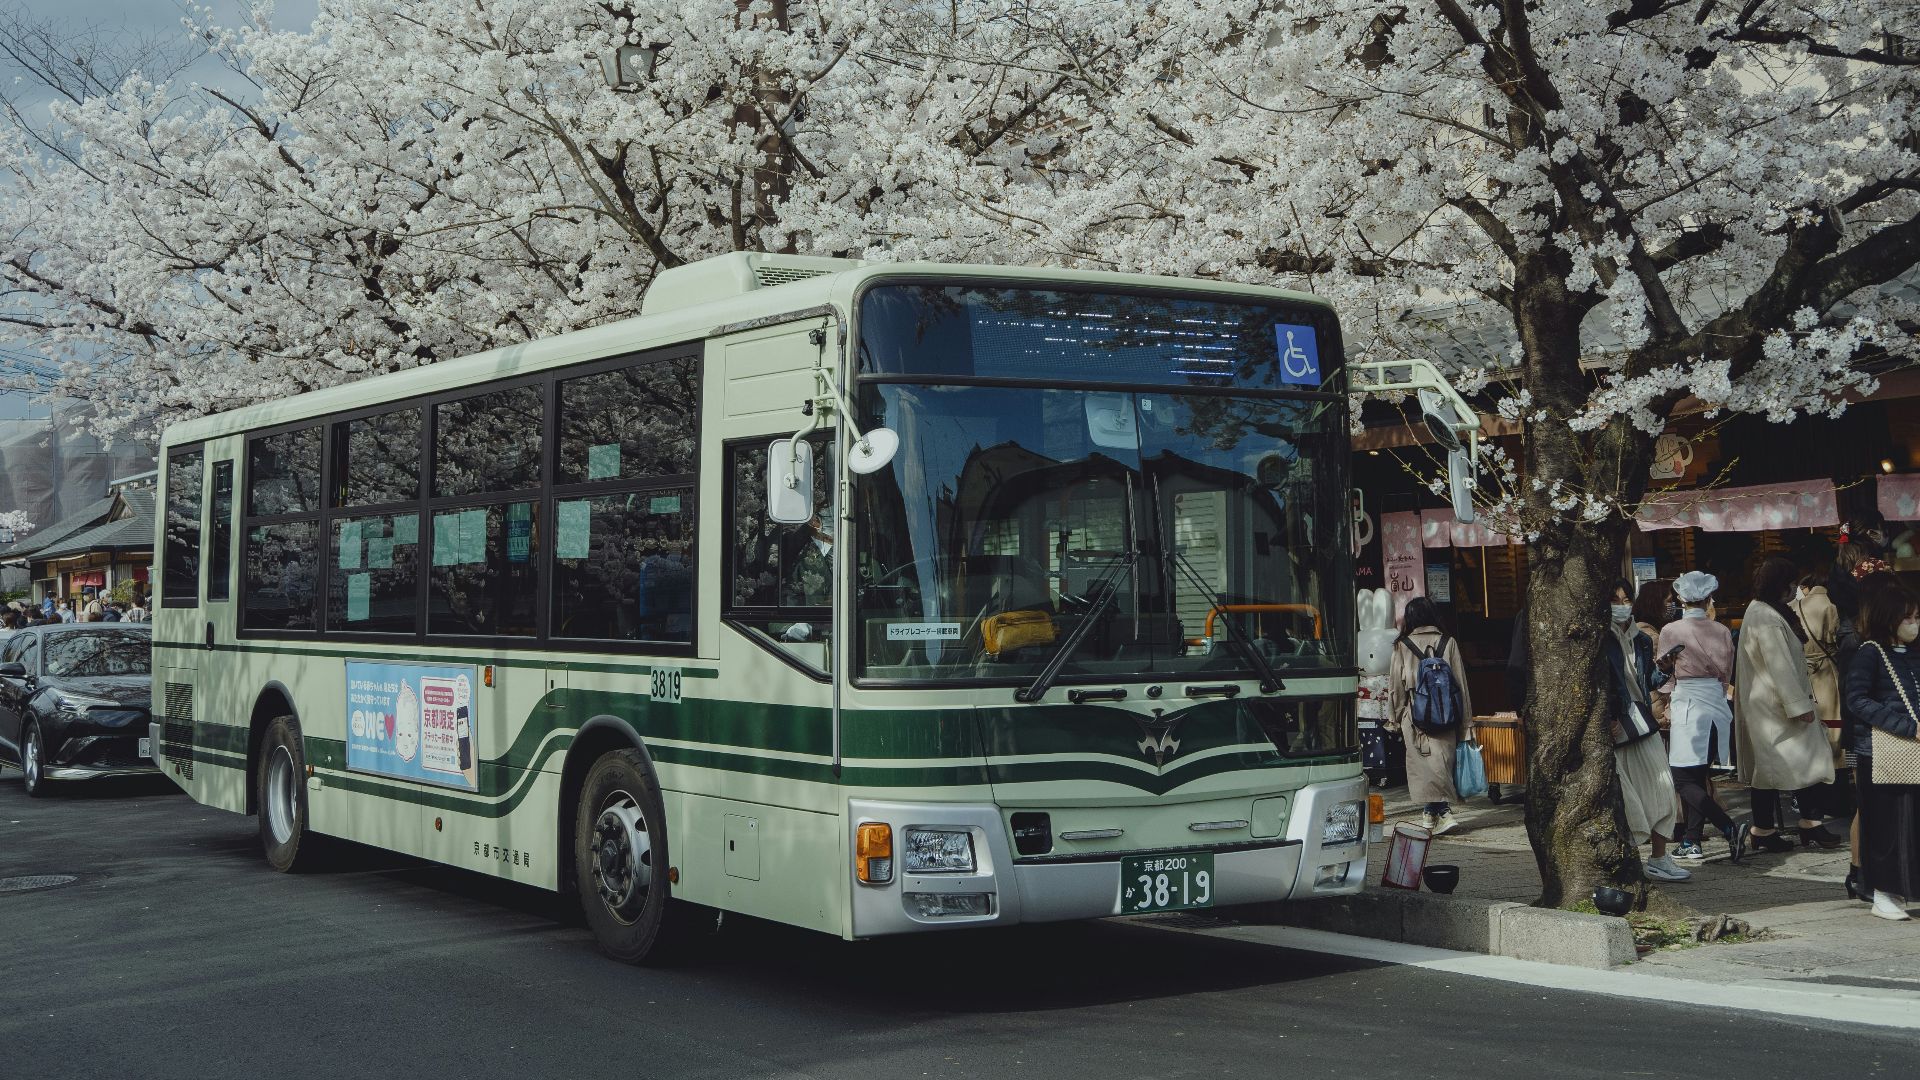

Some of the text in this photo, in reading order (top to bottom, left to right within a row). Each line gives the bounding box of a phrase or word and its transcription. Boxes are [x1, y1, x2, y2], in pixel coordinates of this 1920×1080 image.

[651, 669, 681, 700] 3819
[424, 708, 455, 731] 京都限定
[474, 841, 530, 868] 京都市交通局
[1125, 870, 1210, 908] か 38-19
